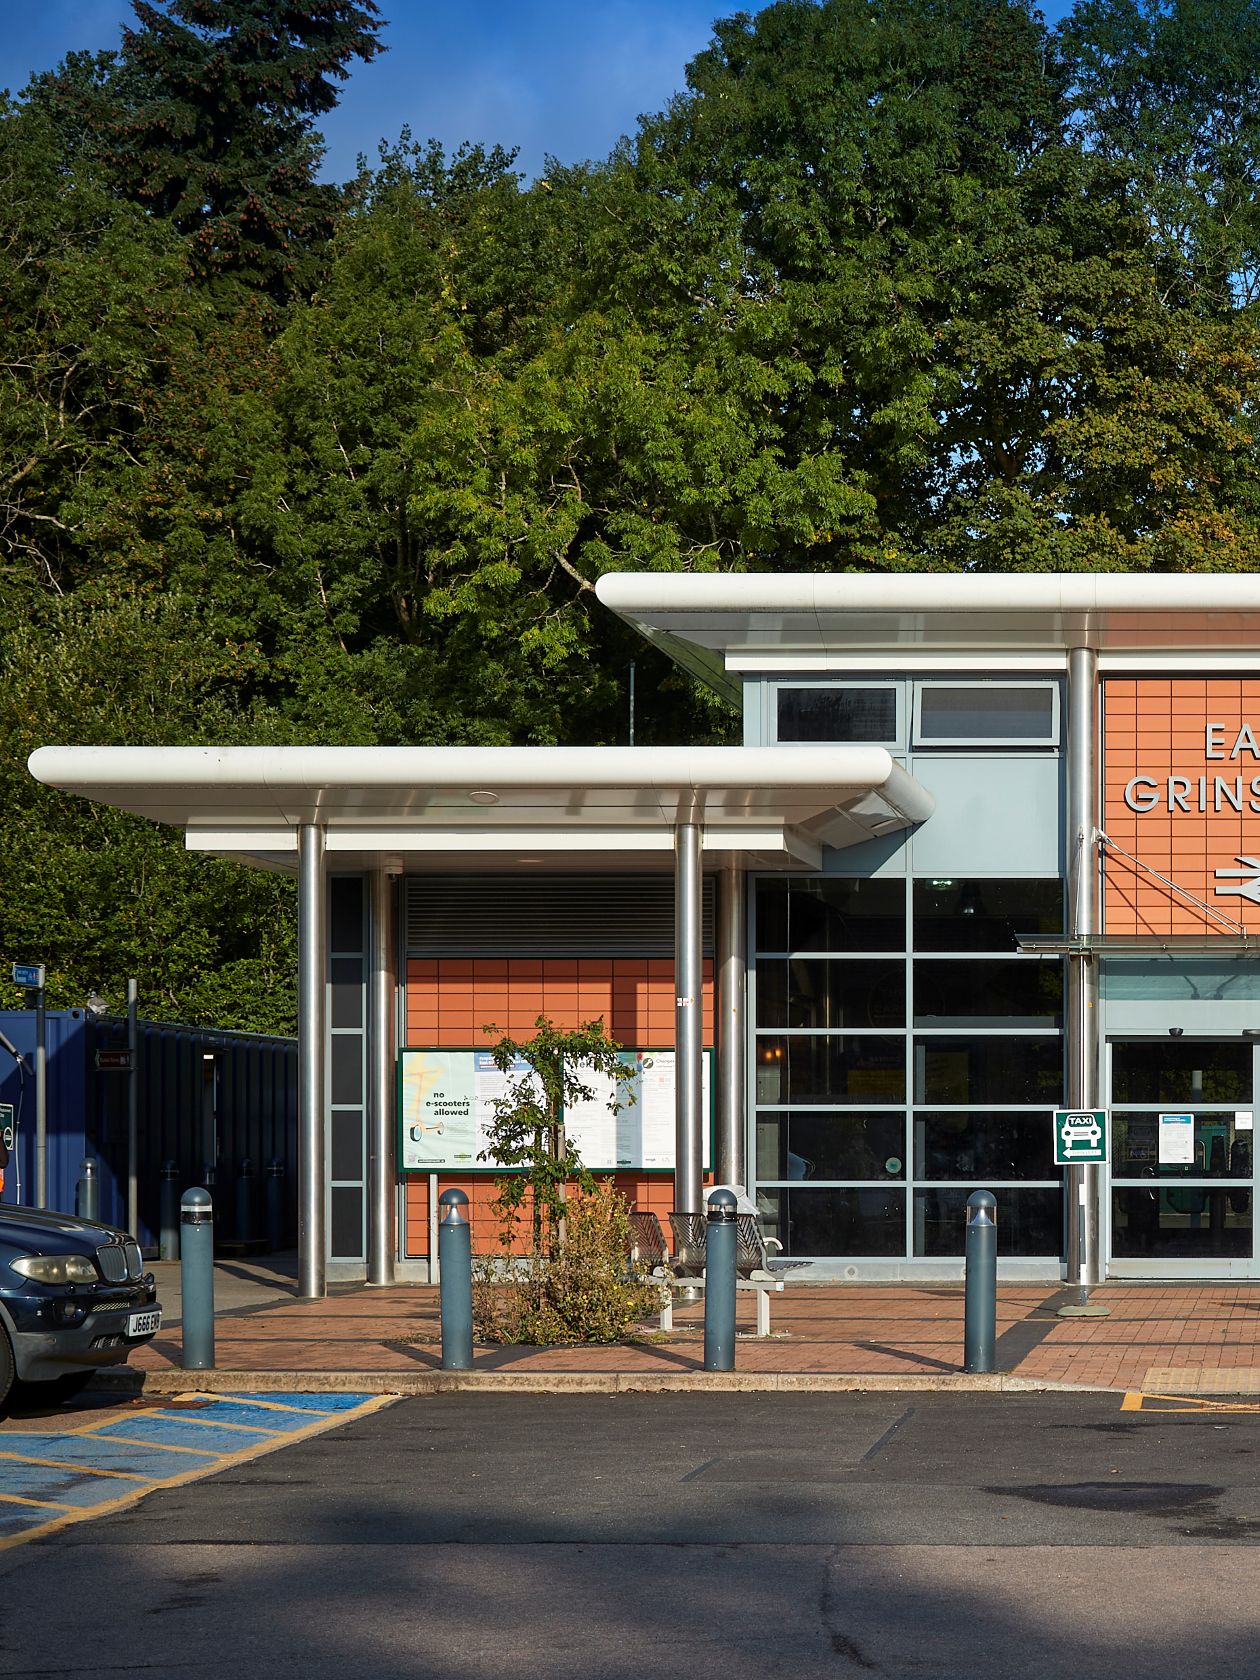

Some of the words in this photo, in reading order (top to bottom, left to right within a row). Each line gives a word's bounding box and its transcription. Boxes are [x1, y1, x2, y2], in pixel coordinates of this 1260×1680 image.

[434, 1108, 469, 1116] allowed
[1069, 1117, 1092, 1125] TAXI
[133, 1316, 150, 1332] J666
